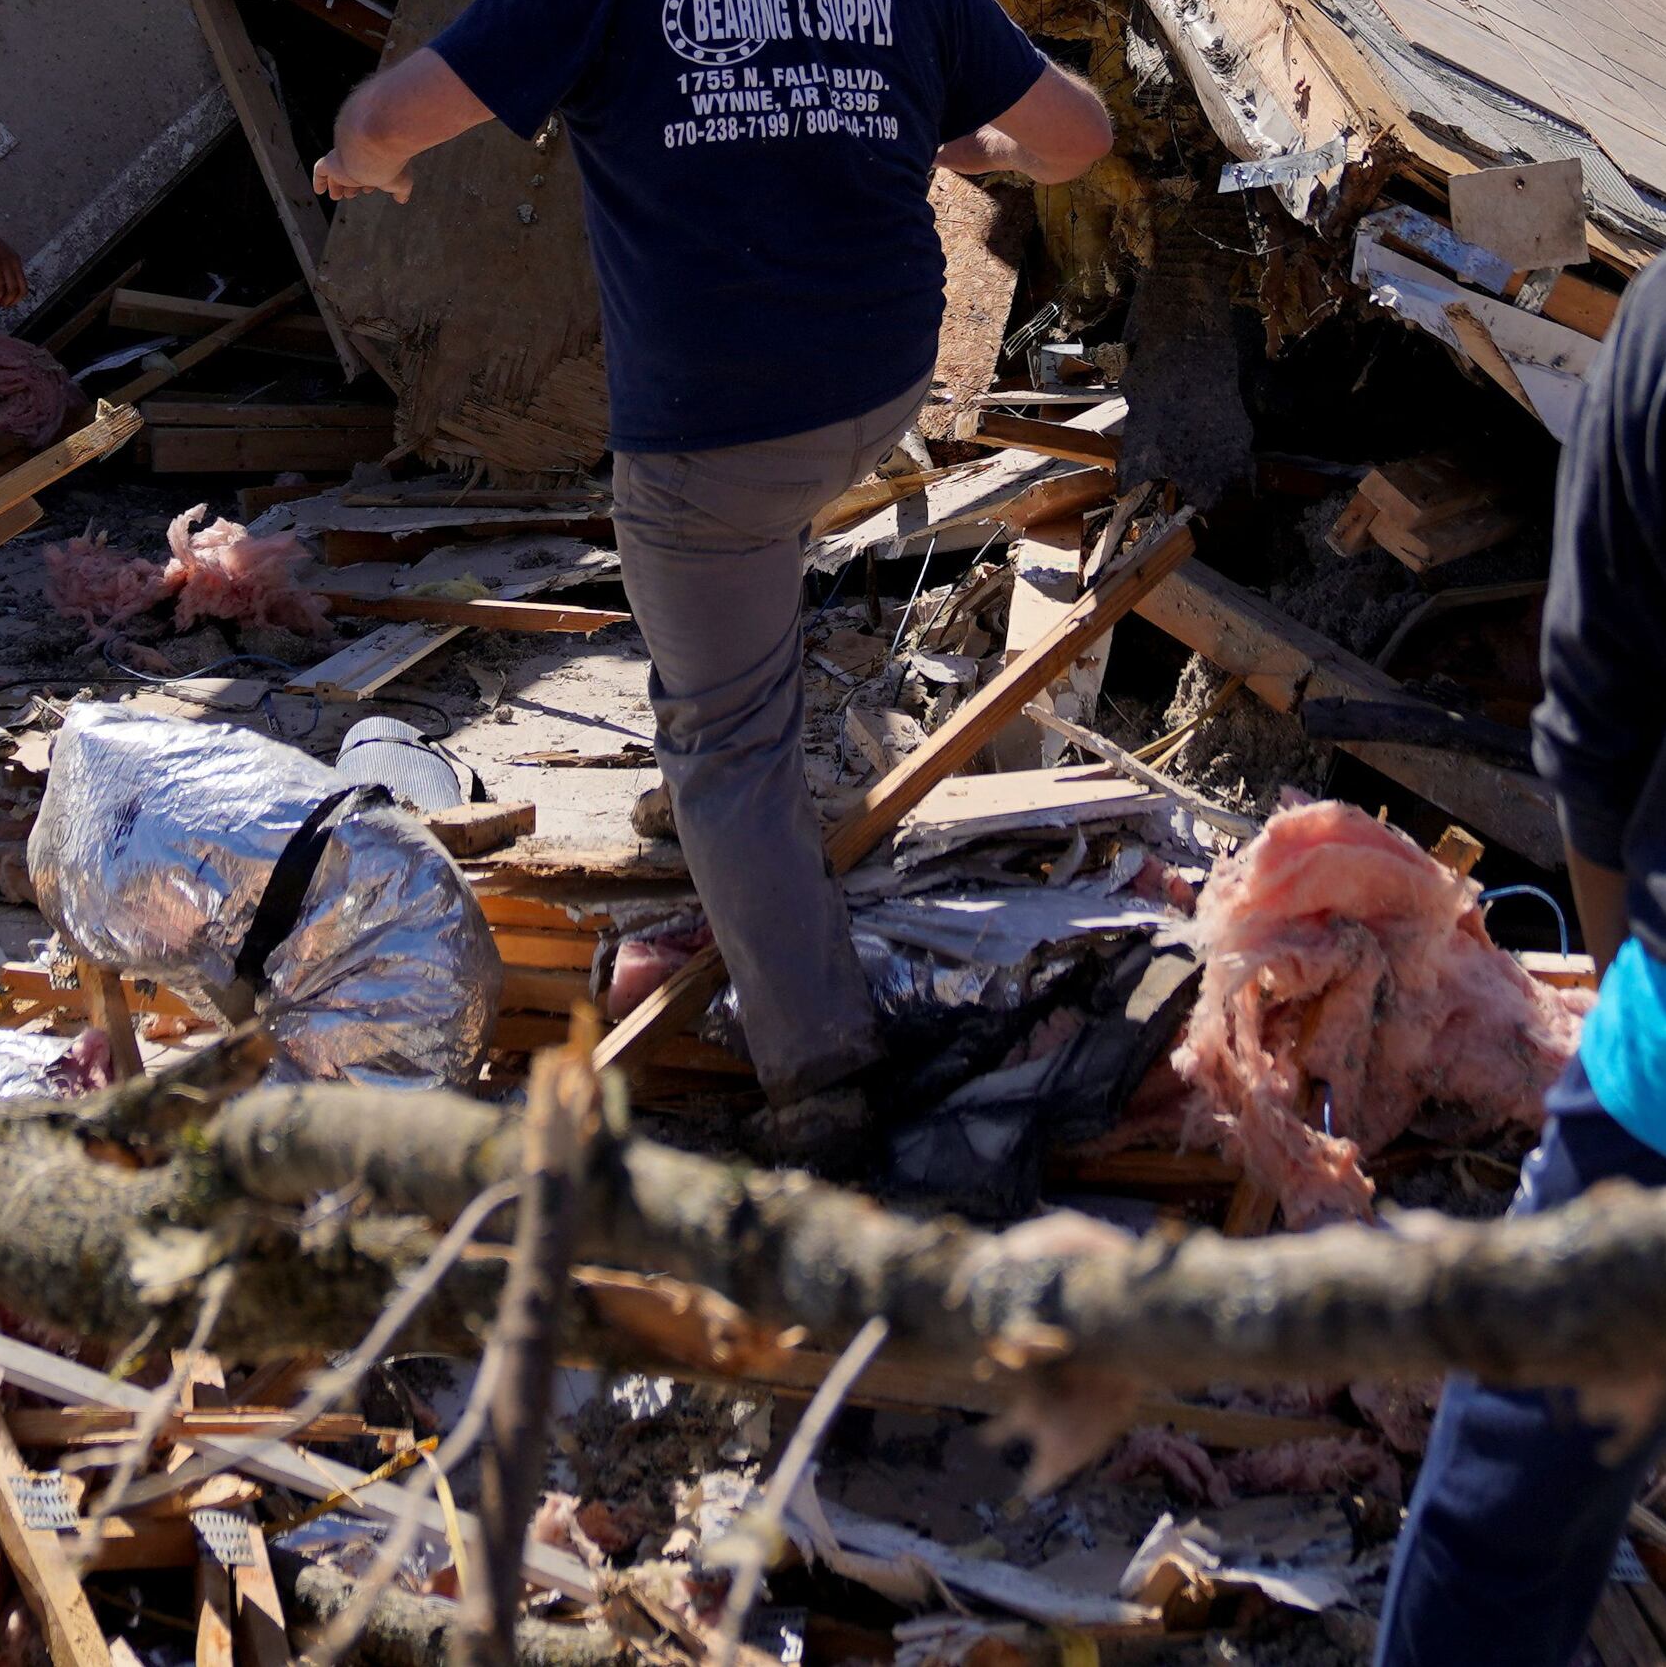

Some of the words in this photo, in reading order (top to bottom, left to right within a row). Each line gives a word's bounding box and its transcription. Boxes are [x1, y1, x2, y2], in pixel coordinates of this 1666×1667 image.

[676, 70, 736, 95] 1755
[743, 66, 765, 89] N.
[832, 68, 890, 91] BLVD.
[691, 88, 782, 117] WYNNE,
[789, 86, 821, 108] AR
[826, 85, 880, 112] 2396
[664, 112, 789, 149] 870-238-7199
[793, 110, 801, 138] /
